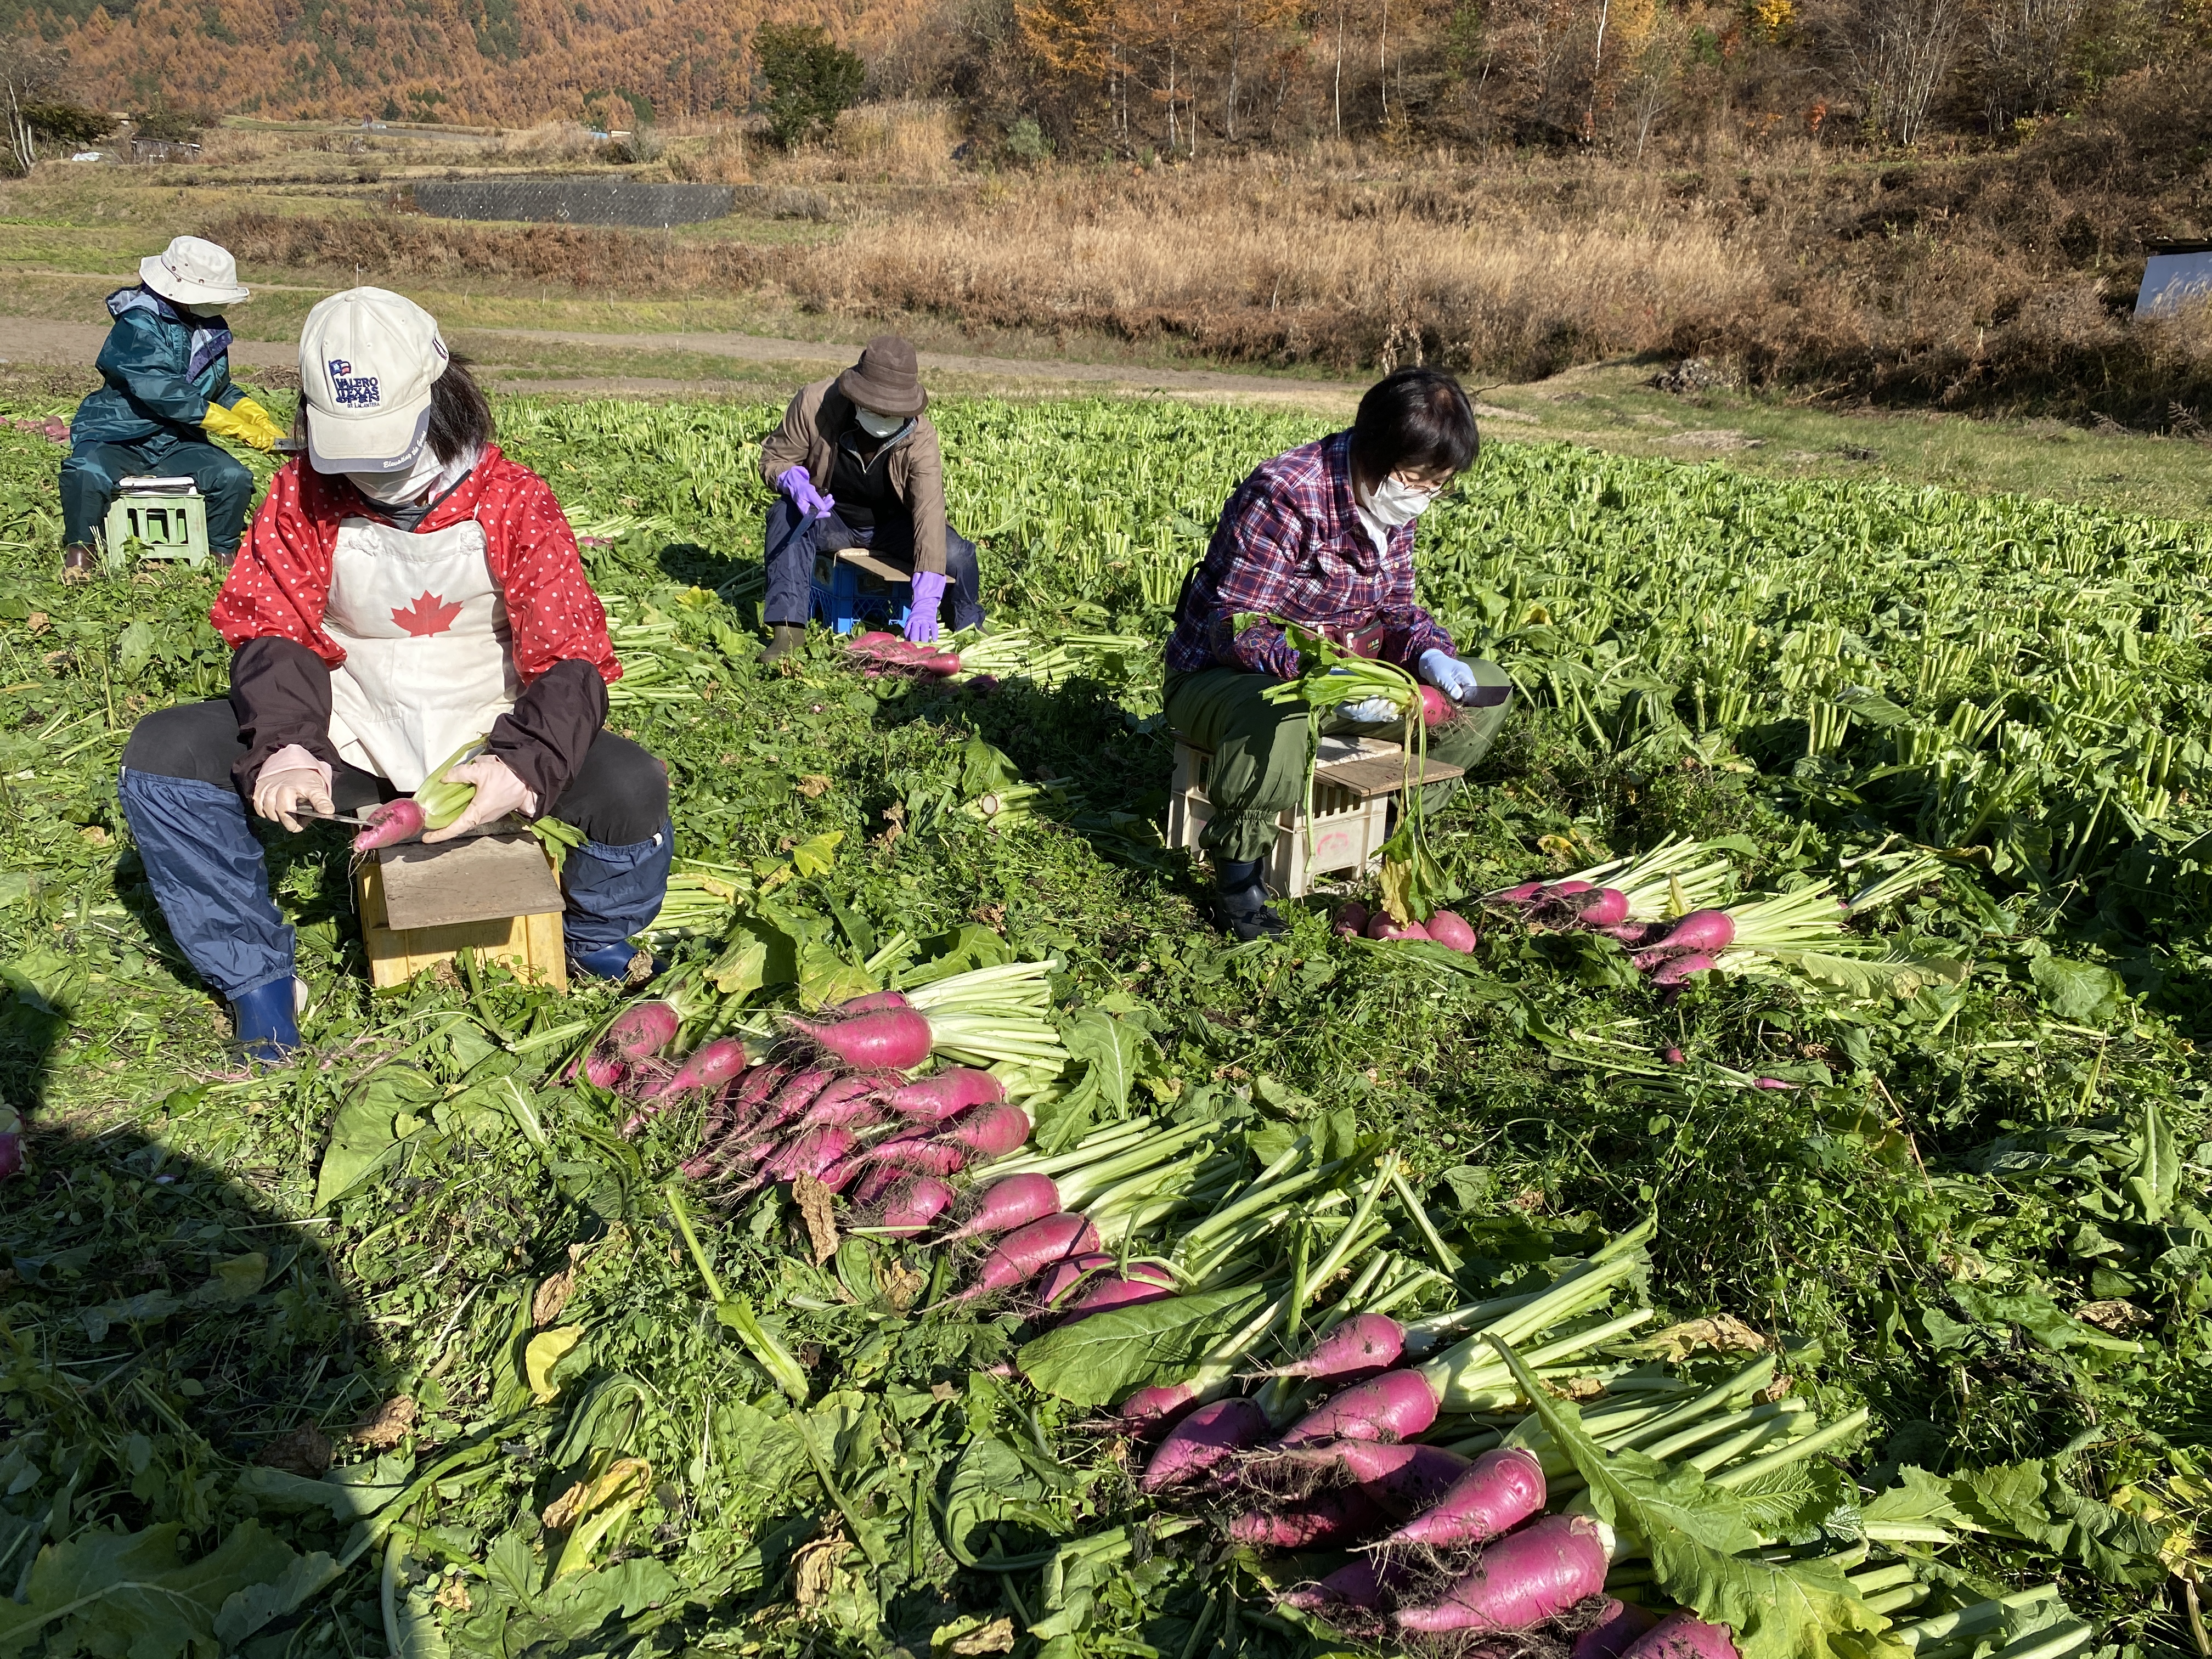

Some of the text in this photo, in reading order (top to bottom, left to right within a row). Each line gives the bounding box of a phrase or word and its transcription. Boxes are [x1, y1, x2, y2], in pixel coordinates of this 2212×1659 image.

[335, 377, 378, 388] VALERO
[338, 386, 379, 397] TEXAS
[336, 395, 380, 403] OPEN
[383, 453, 412, 469] Elevating
[416, 430, 427, 448] Game
